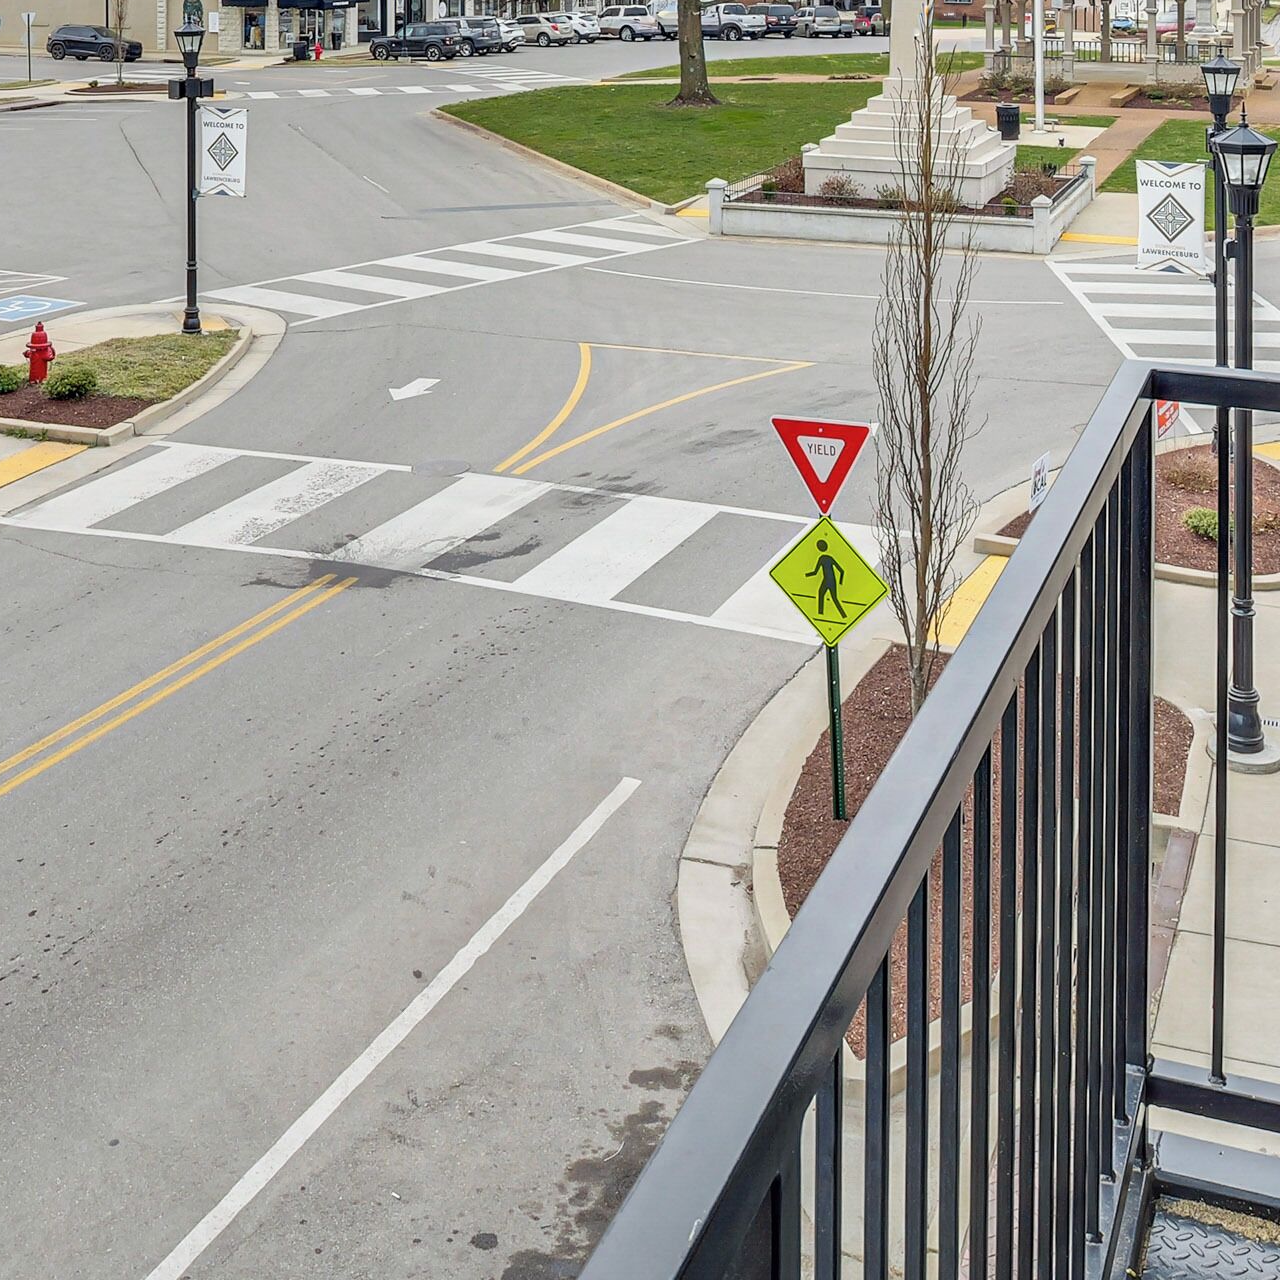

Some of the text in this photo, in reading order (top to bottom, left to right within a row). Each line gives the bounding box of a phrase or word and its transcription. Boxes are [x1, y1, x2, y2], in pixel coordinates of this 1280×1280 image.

[203, 121, 234, 129] WELCOME
[1140, 179, 1201, 191] WELCOME TO
[1142, 248, 1199, 258] LAWRENCEBURG
[807, 443, 836, 456] YIELD
